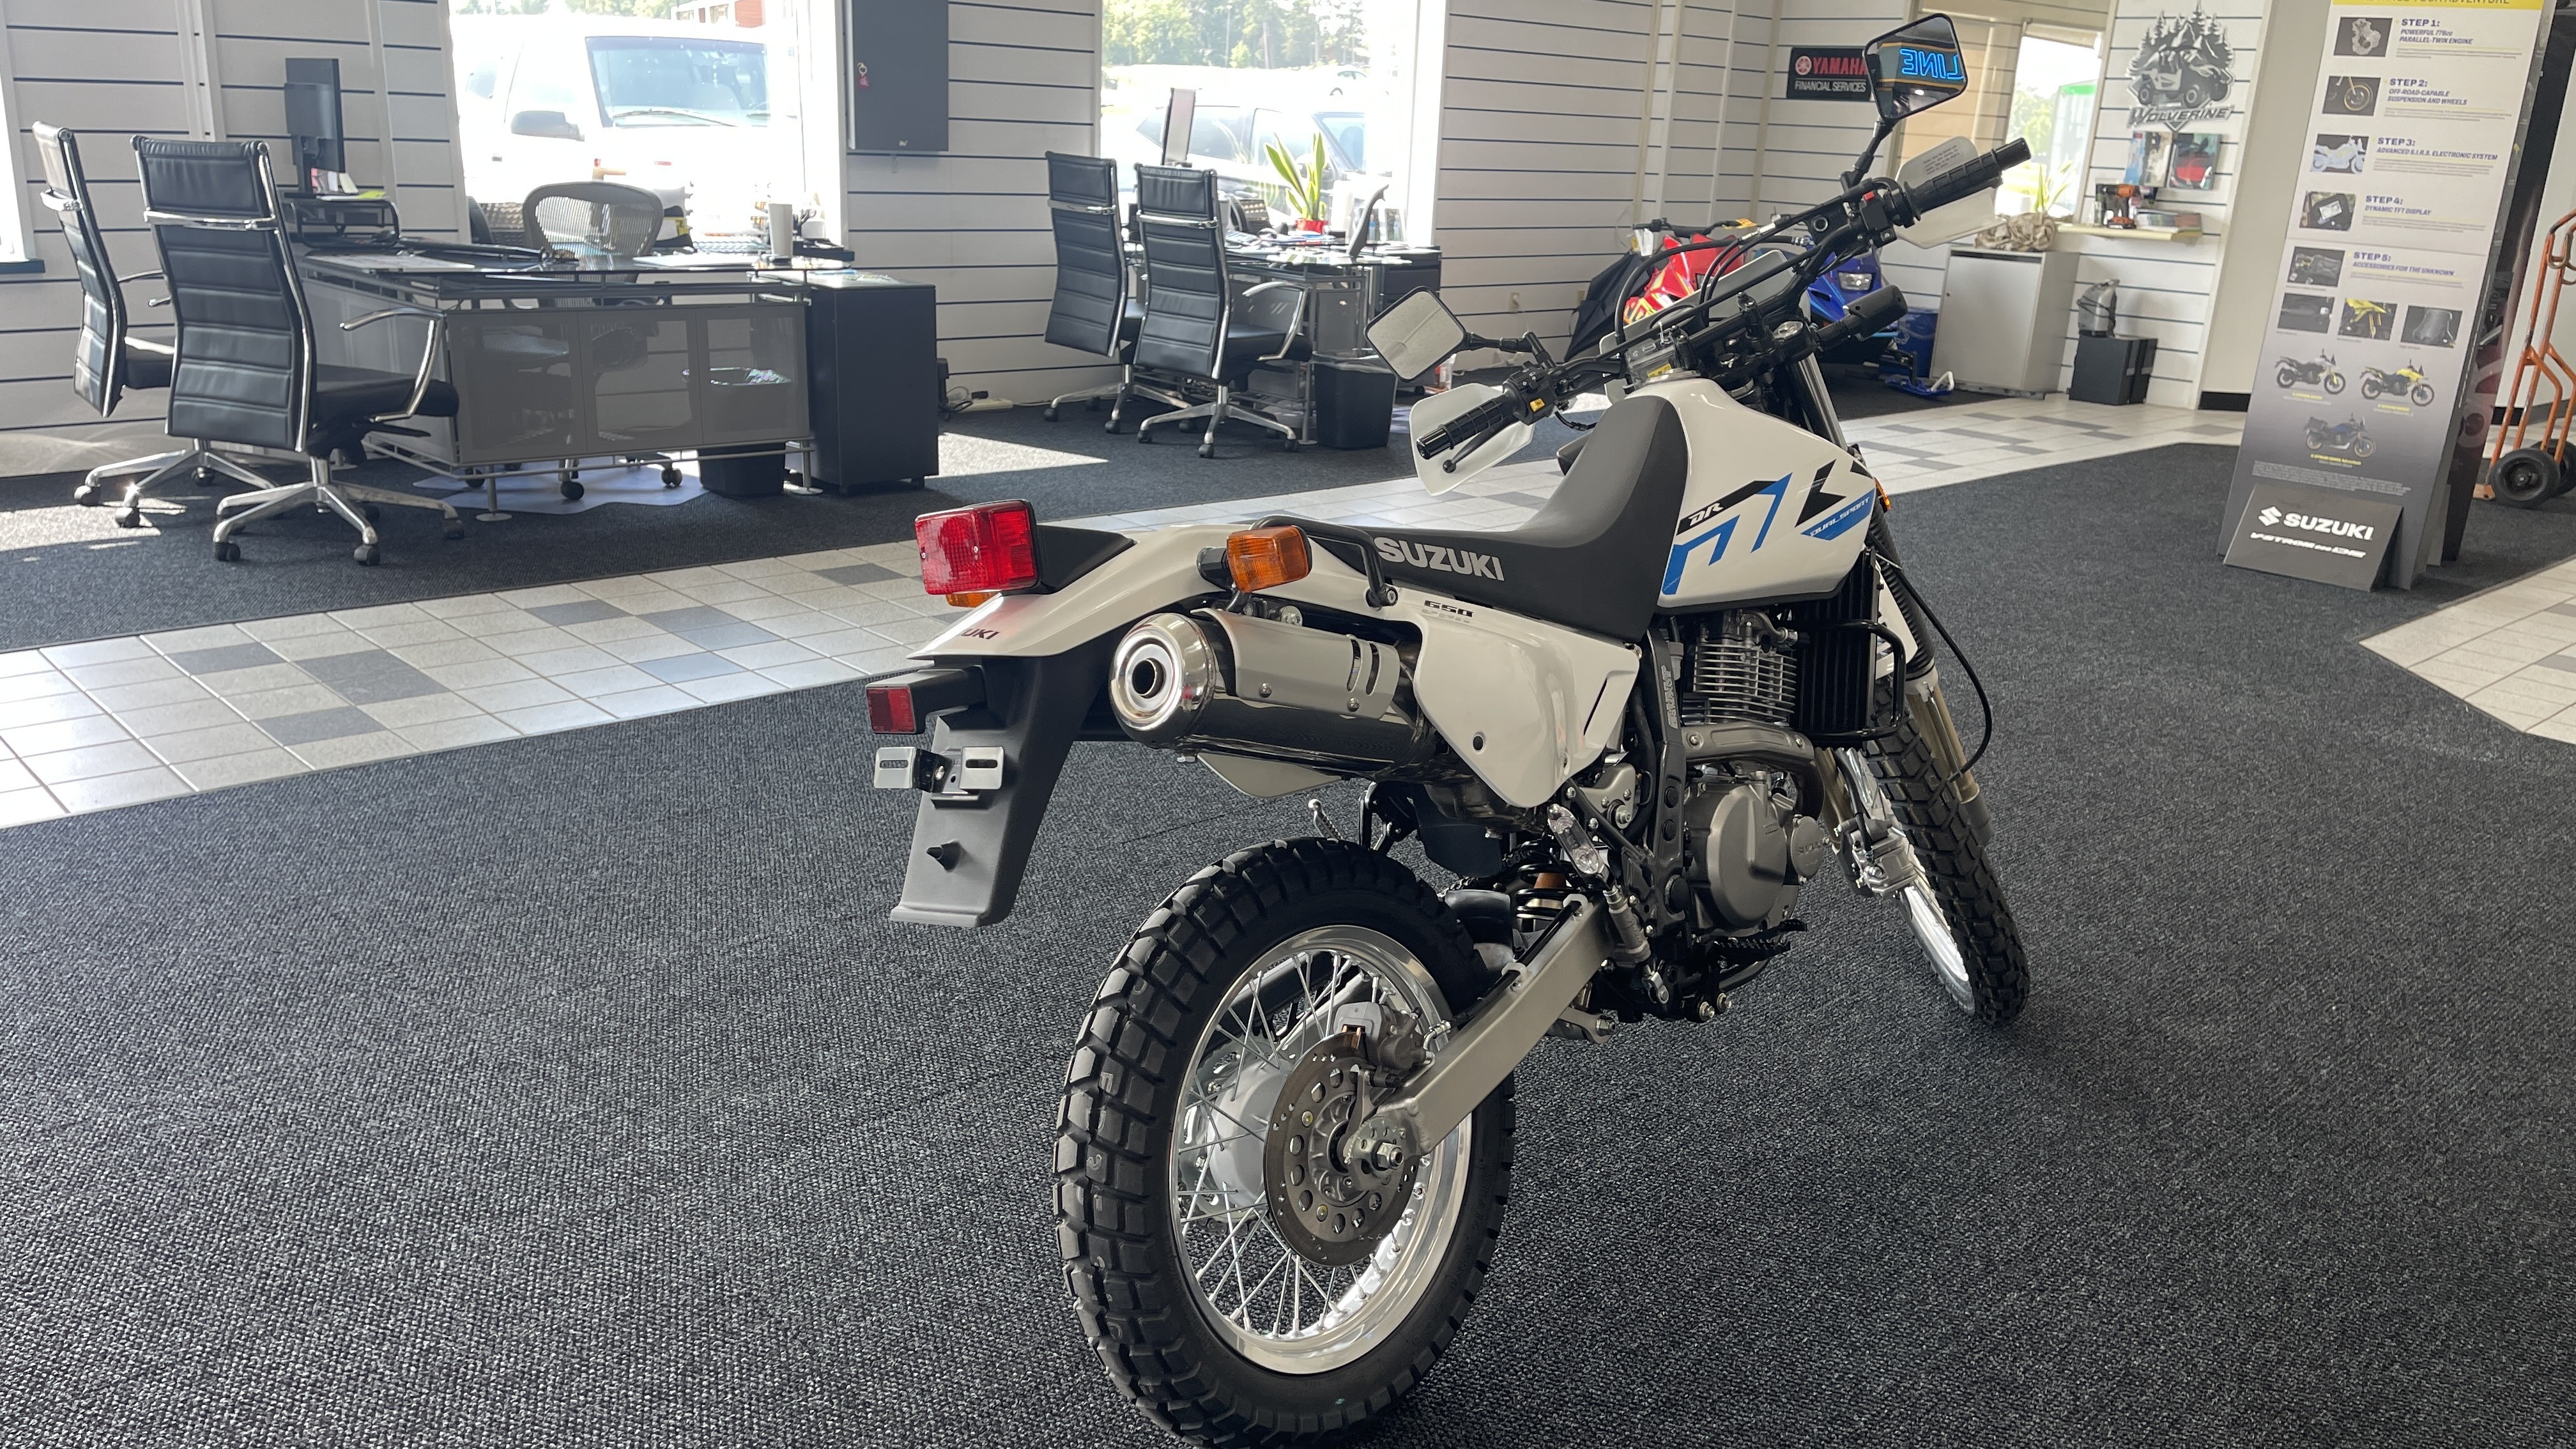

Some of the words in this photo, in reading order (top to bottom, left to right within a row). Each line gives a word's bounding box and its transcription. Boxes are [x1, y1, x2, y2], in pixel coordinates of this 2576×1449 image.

[2402, 19, 2430, 27] STEP
[1813, 56, 1869, 75] YAMAHA
[1795, 80, 1832, 91] FINANCIAL
[1832, 81, 1866, 93] SERVICES
[2389, 78, 2418, 87] STEP
[2418, 79, 2428, 88] 2:
[2377, 137, 2405, 146] STEP
[2405, 139, 2416, 147] 3:
[2377, 147, 2410, 155] ADVANCED
[2432, 150, 2472, 158] ELECTRONIC
[2472, 152, 2498, 160] SYSTEM
[2366, 195, 2393, 204] STEP
[2405, 208, 2432, 216] DISPLAY
[2353, 251, 2381, 261] STEP
[1687, 502, 1724, 526] DR
[2283, 512, 2374, 541] SUZUKI
[1374, 537, 1505, 581] SUZUKI
[1424, 600, 1475, 618] 650
